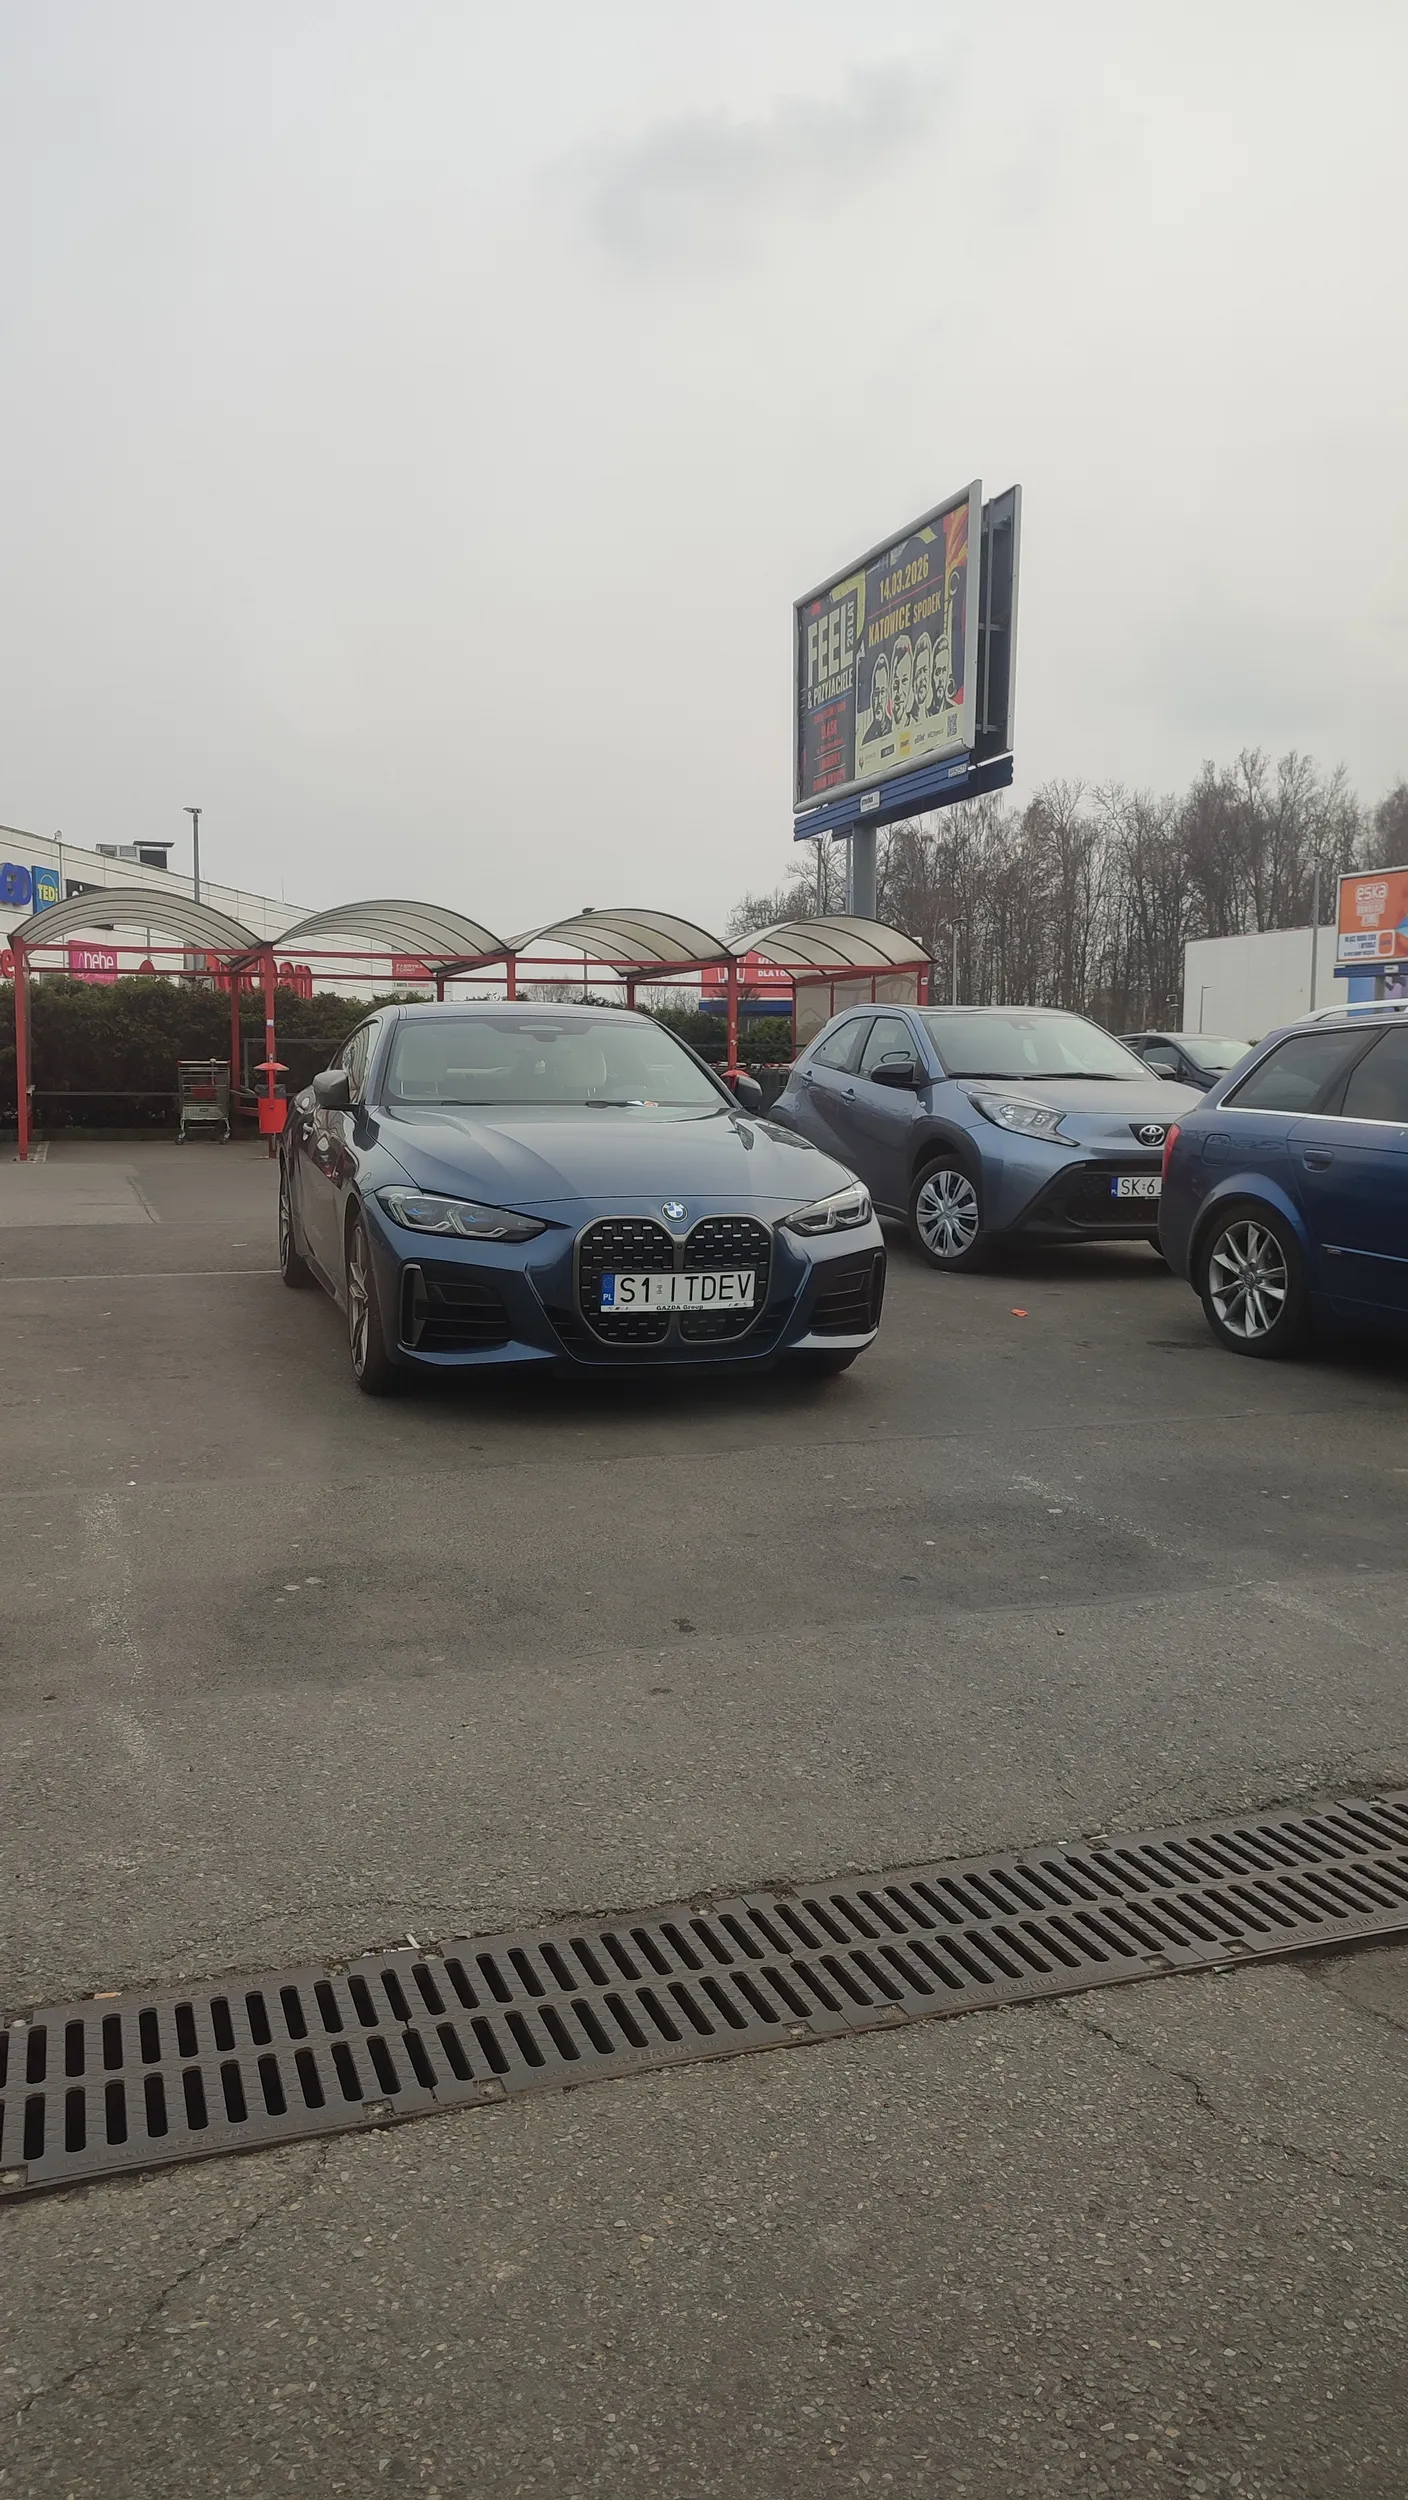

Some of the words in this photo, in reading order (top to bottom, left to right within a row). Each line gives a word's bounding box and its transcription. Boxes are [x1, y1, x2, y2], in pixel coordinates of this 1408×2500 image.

[879, 553, 929, 604] 14.03.2026
[847, 600, 855, 626] LAT
[868, 602, 912, 648] KATOWICE
[913, 590, 942, 624] SPODEK
[807, 603, 854, 689] FEEL
[847, 627, 854, 648] 20
[807, 690, 813, 710] &
[37, 883, 59, 903] TEDi
[1121, 1178, 1141, 1195] SK
[602, 1293, 613, 1301] PL
[619, 1277, 650, 1303] S1
[682, 1303, 704, 1311] Group
